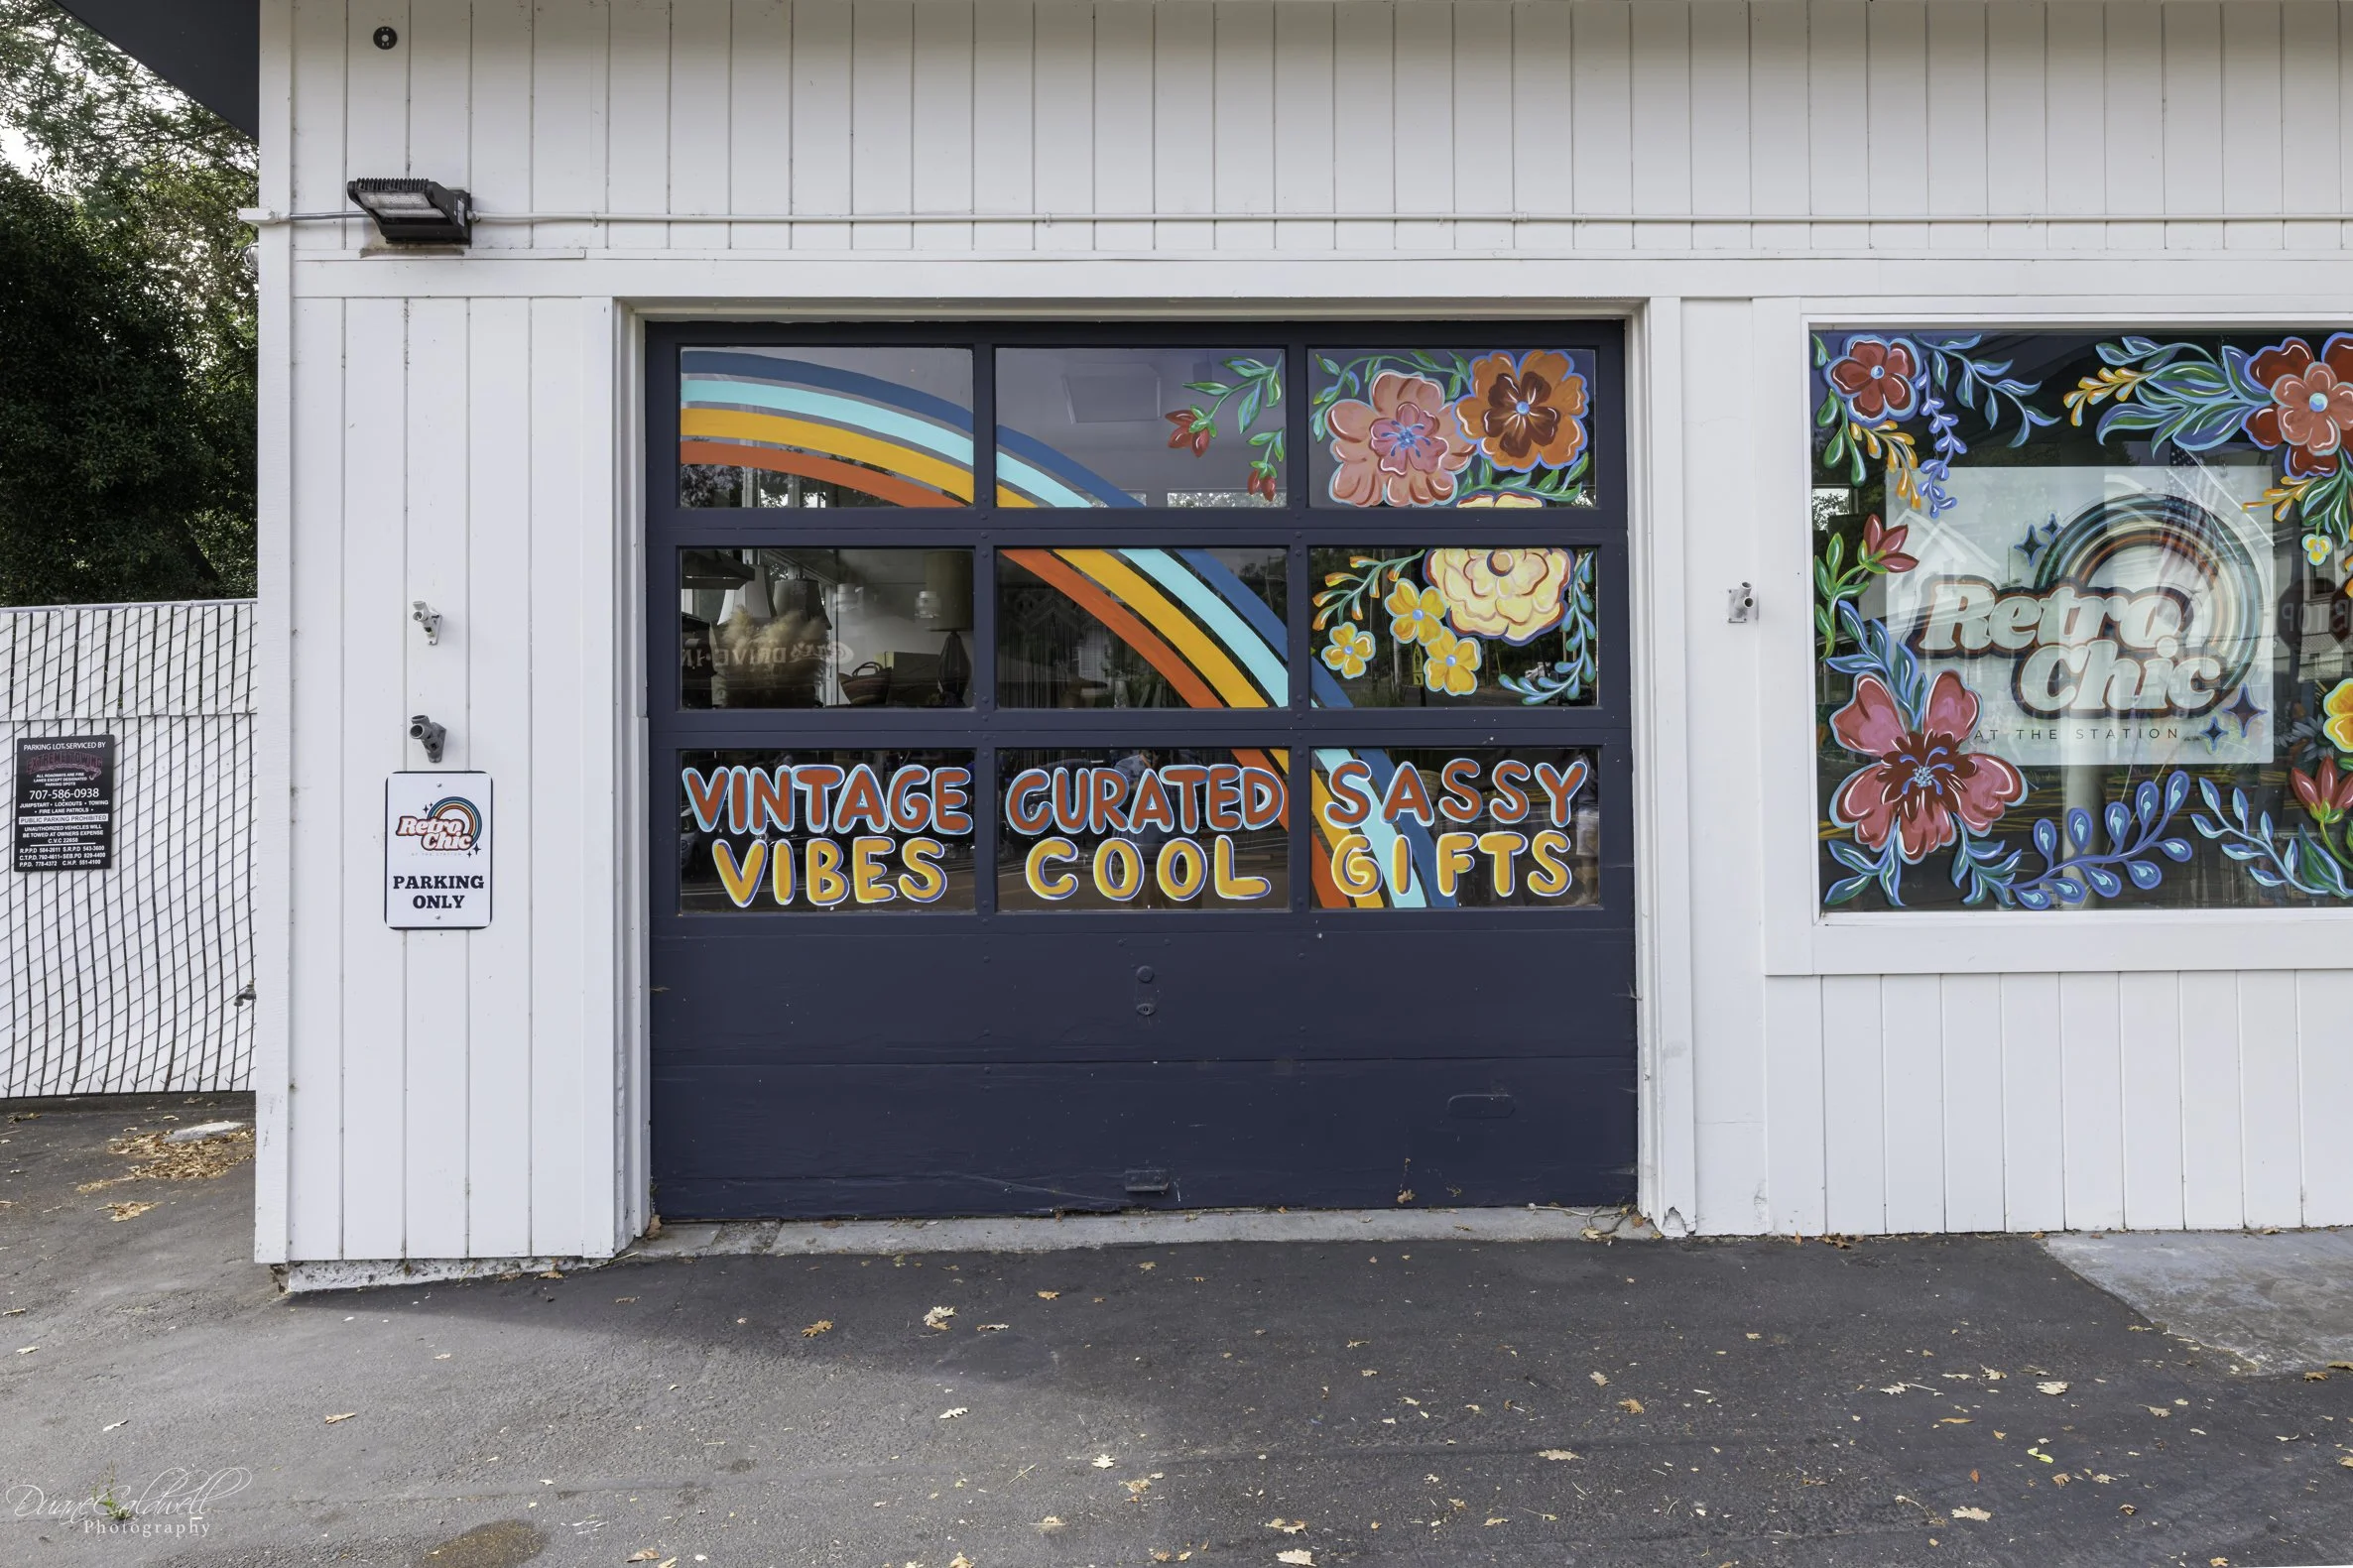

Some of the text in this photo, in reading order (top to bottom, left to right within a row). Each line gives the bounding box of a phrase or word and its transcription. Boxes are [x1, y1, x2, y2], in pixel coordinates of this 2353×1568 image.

[1911, 576, 2190, 657] Retro
[2014, 636, 2226, 714] Chic
[67, 751, 103, 769] TOWING
[1973, 727, 2179, 741] AT THE STATION
[29, 787, 99, 800] 707-586-0938
[396, 816, 465, 836] Retro
[681, 763, 975, 835] VINTAGE
[1005, 763, 1286, 836] CURATED
[1324, 758, 1588, 828] SASSY
[421, 832, 473, 851] Chic
[711, 836, 948, 907] VIBES
[1025, 834, 1272, 902] COOL
[1330, 829, 1572, 898] GIFTS
[393, 875, 485, 890] PARKING
[412, 895, 465, 909] ONLY
